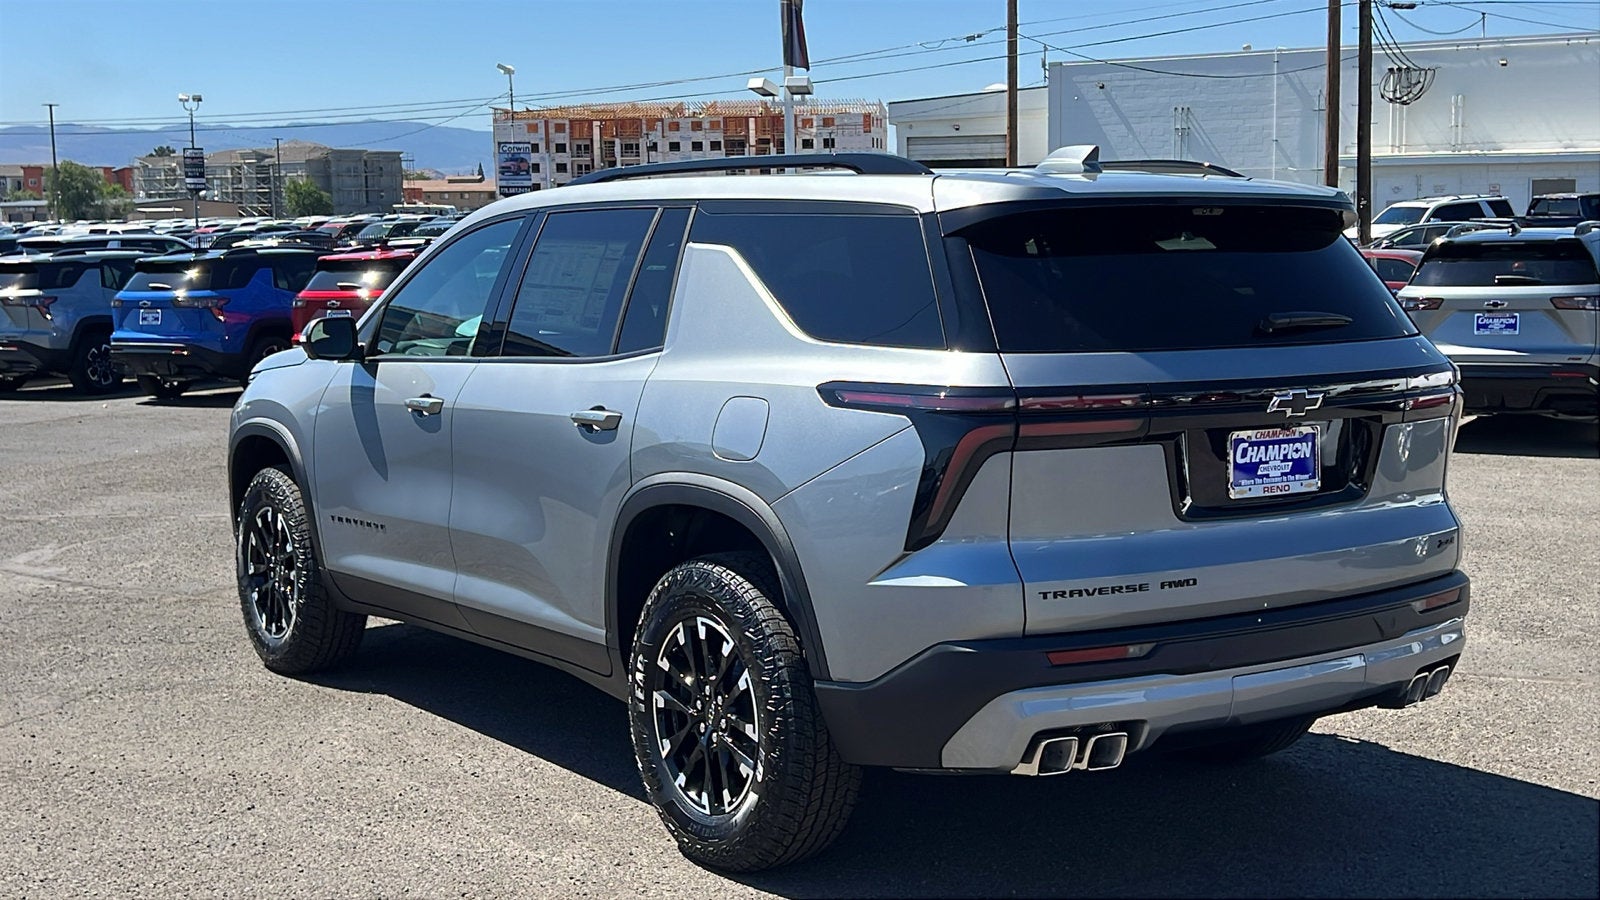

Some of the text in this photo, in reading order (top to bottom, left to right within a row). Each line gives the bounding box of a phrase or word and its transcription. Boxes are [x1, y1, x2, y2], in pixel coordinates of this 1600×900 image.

[501, 145, 530, 153] Corwin
[1255, 429, 1297, 439] CHAMPION
[1235, 441, 1312, 464] CHAMPION
[1259, 464, 1290, 473] CHEVROLET
[1262, 484, 1291, 494] RENO
[1038, 577, 1198, 600] TRAVERSE AWD
